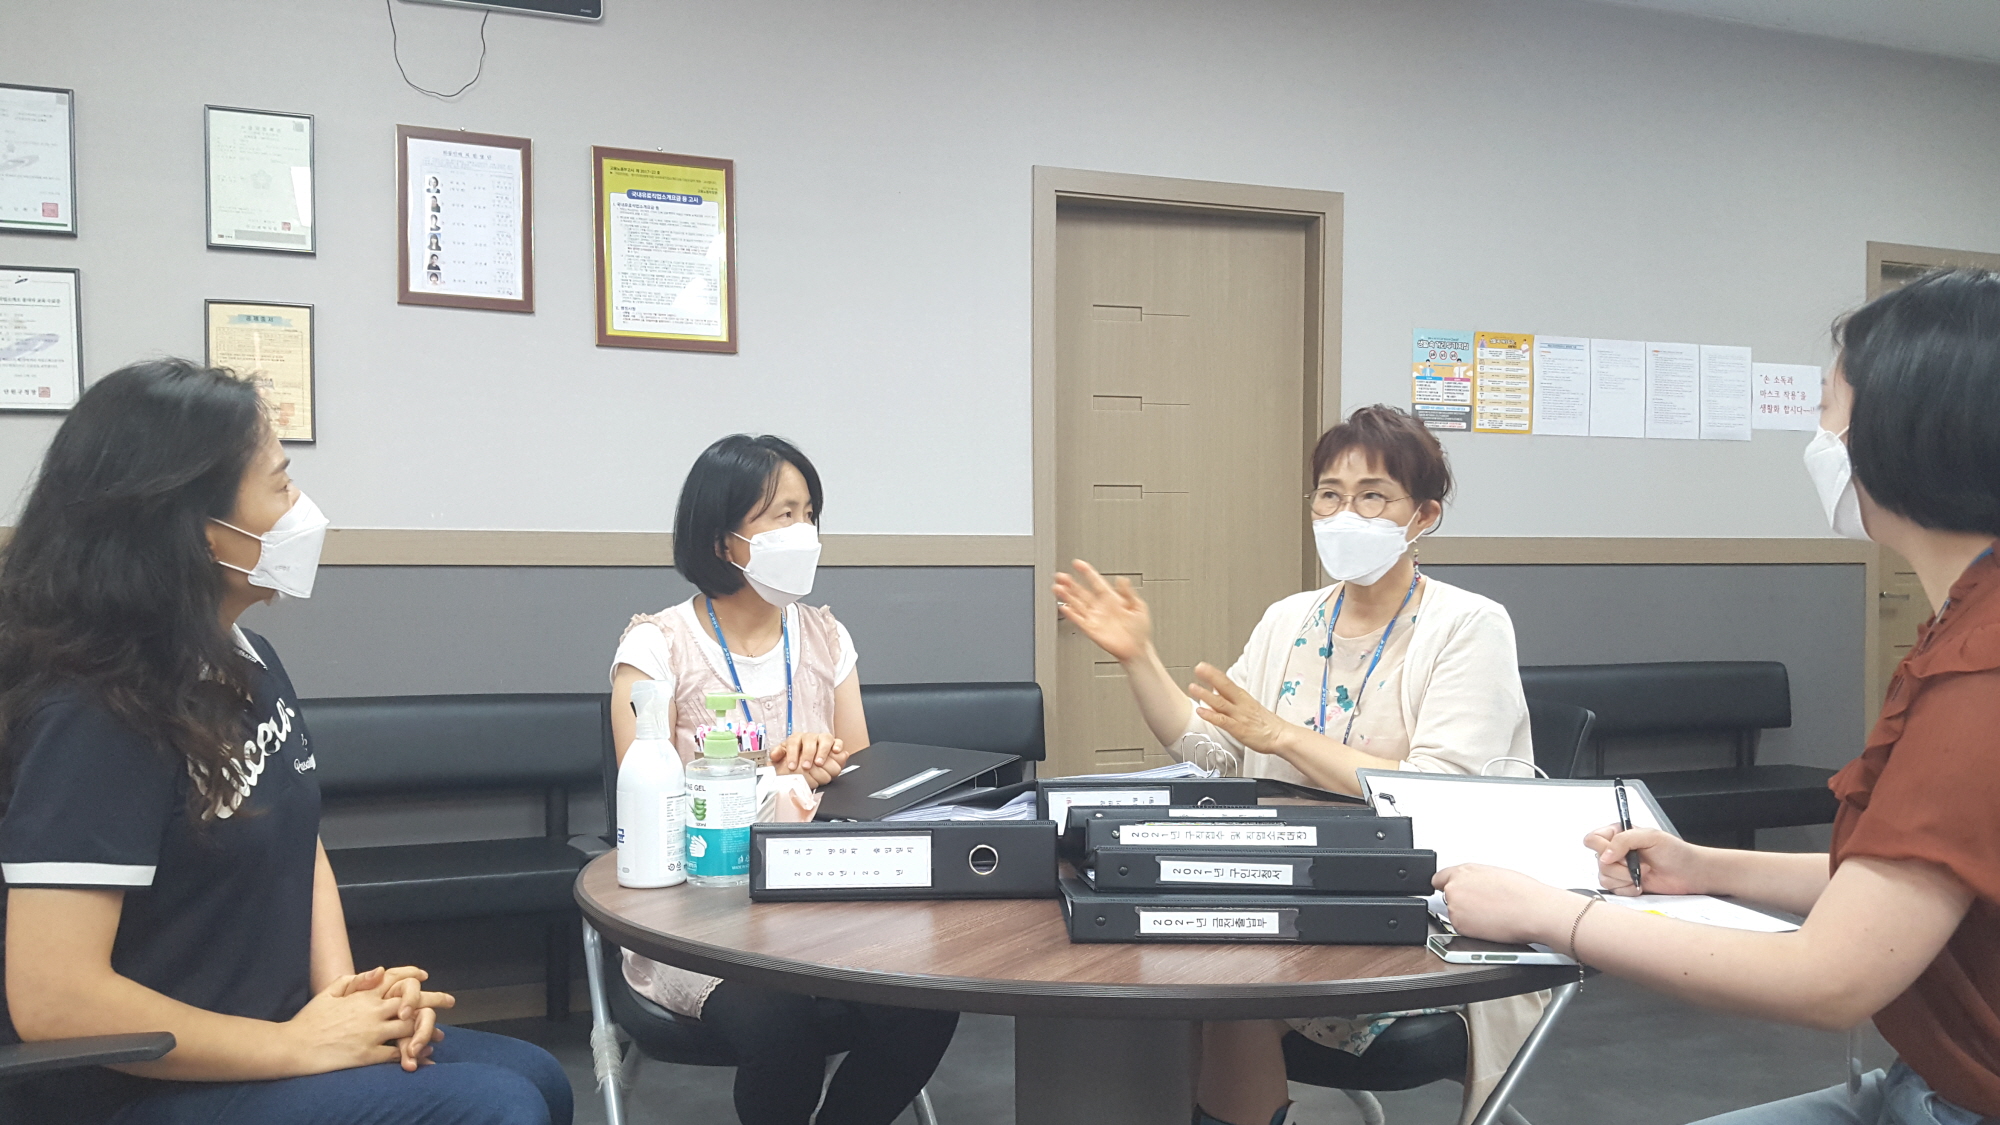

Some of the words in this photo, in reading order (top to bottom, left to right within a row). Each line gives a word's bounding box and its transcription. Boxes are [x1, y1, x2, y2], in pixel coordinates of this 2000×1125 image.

[631, 190, 682, 202] 국내유료직업소개요금
[1774, 376, 1794, 385] 소독과
[1760, 389, 1780, 398] 마스크
[1759, 404, 1780, 414] 생활화
[694, 784, 706, 792] GEL
[1131, 831, 1180, 840] 2021년
[1185, 831, 1225, 840] 구직접수
[1172, 867, 1225, 878] 2021년
[1229, 868, 1283, 880] 구인신청서
[1153, 917, 1207, 928] 2021년
[1212, 917, 1267, 928] 금전출납부
